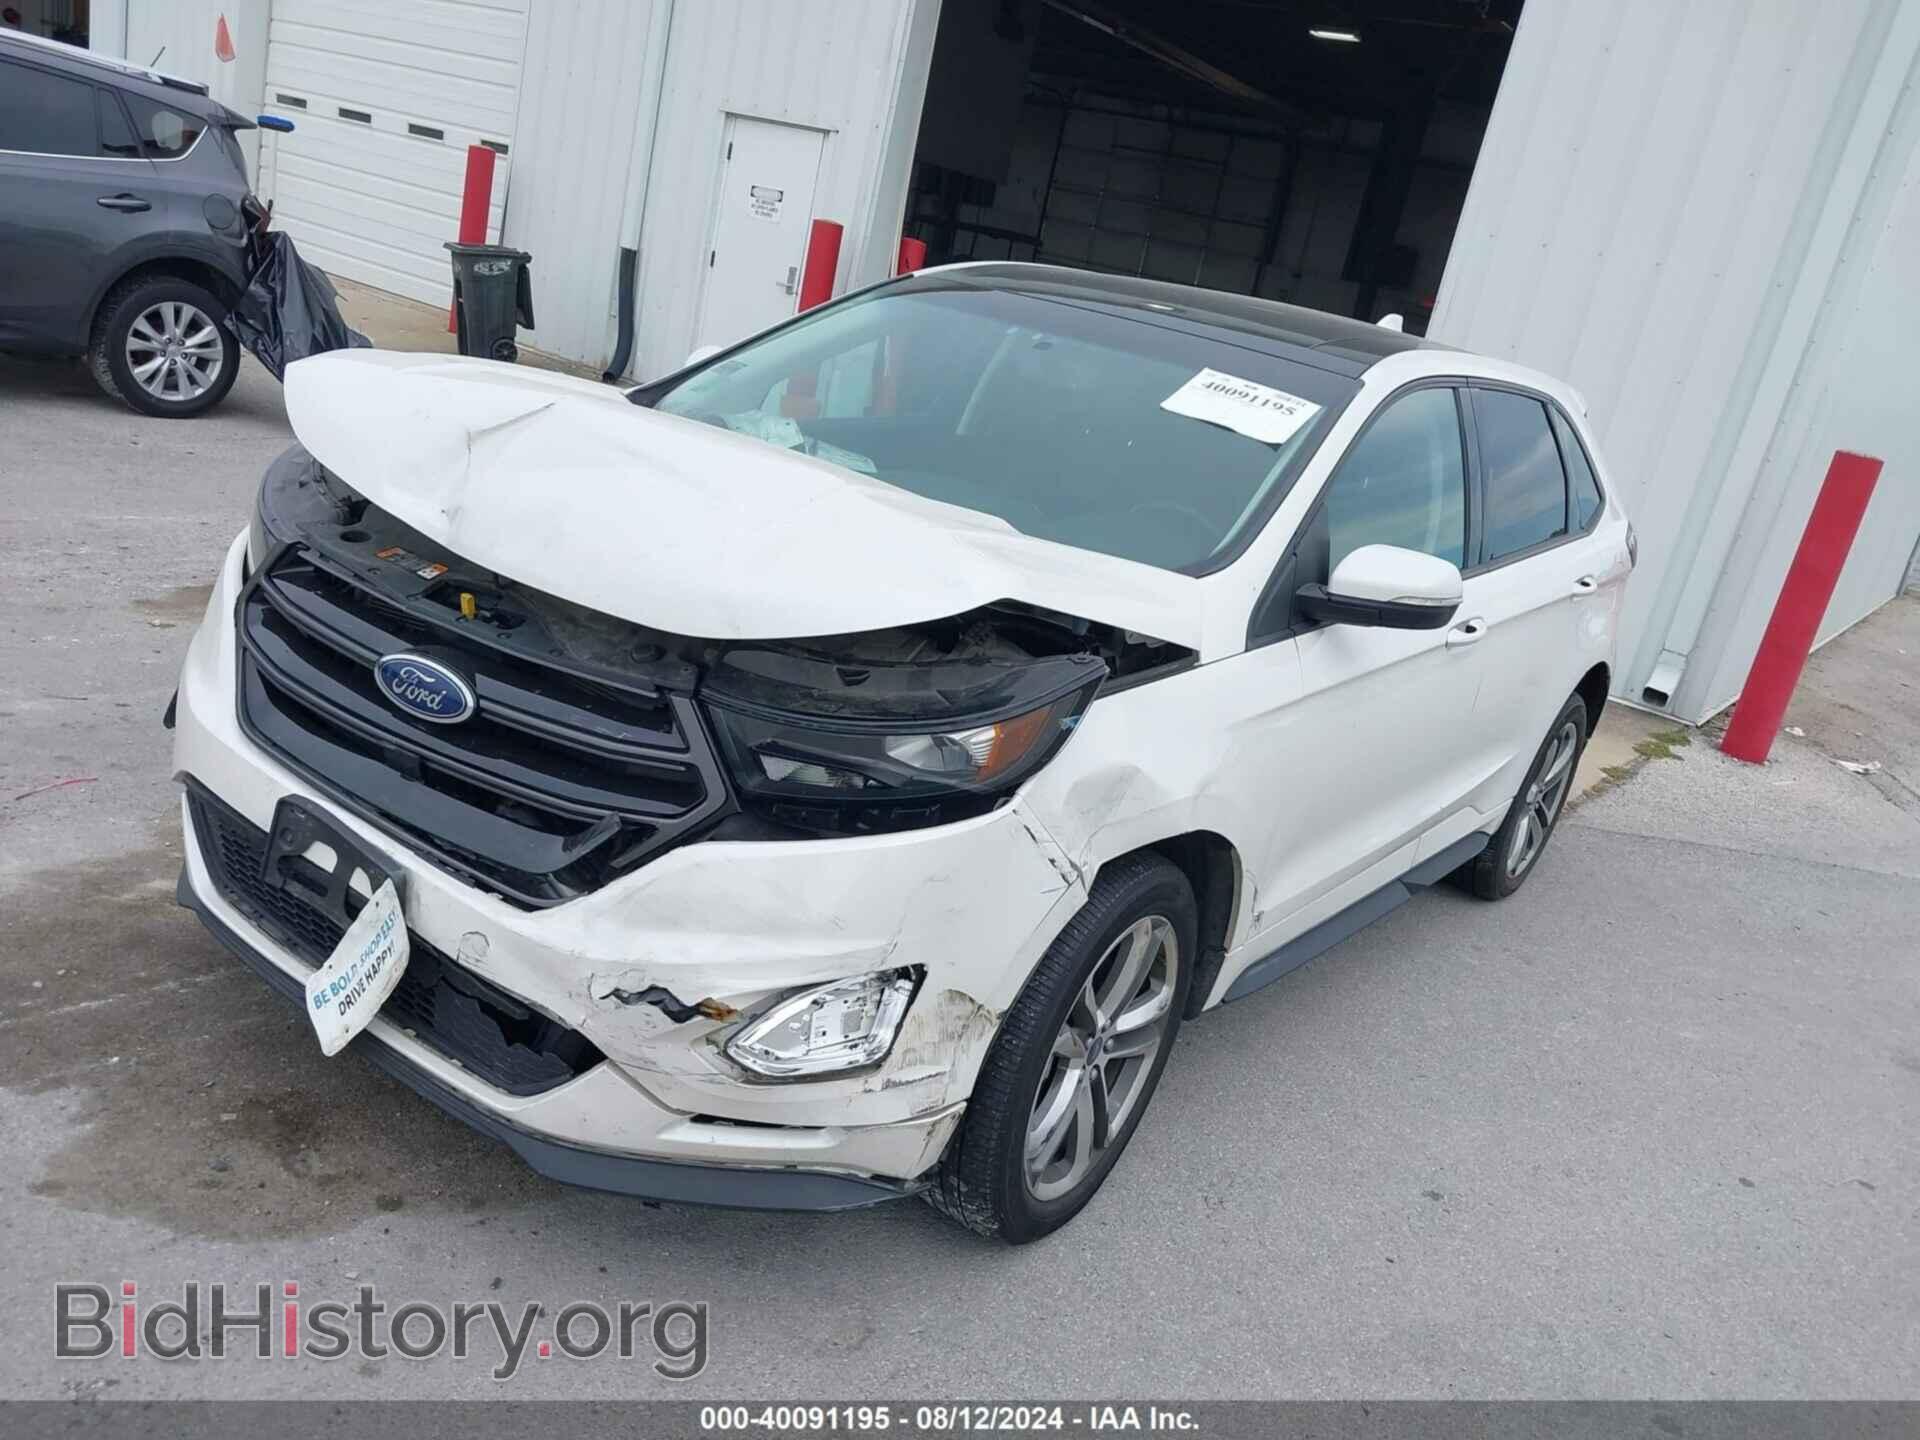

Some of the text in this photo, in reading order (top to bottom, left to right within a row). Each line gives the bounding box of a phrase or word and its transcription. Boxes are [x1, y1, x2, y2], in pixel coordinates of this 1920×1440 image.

[1202, 381, 1297, 416] 40091195
[392, 666, 447, 710] Ford
[313, 989, 331, 1009] BE
[359, 932, 382, 968] SHOP
[338, 977, 366, 1016] DRIVE
